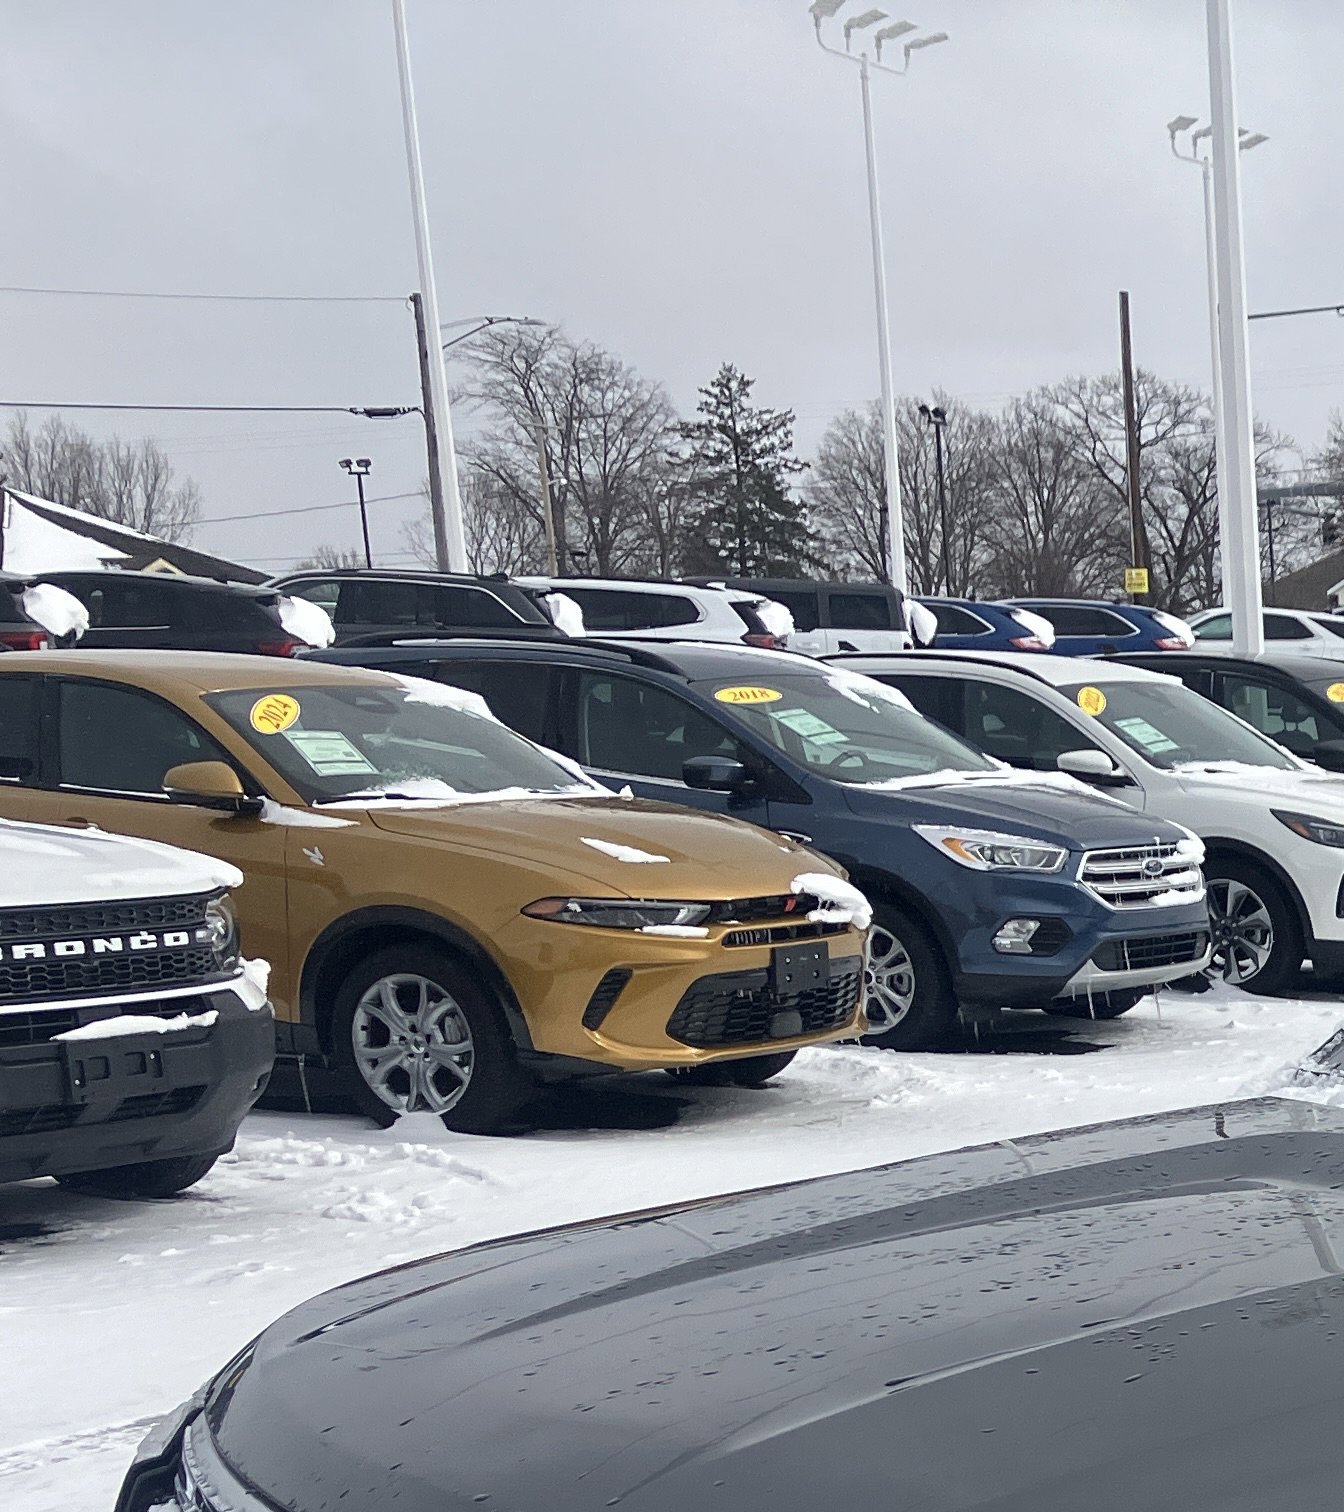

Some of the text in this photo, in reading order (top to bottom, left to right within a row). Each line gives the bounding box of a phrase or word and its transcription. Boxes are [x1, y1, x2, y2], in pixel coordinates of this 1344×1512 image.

[727, 688, 771, 702] 2018
[258, 697, 292, 730] 2024
[0, 931, 190, 960] RONCO
